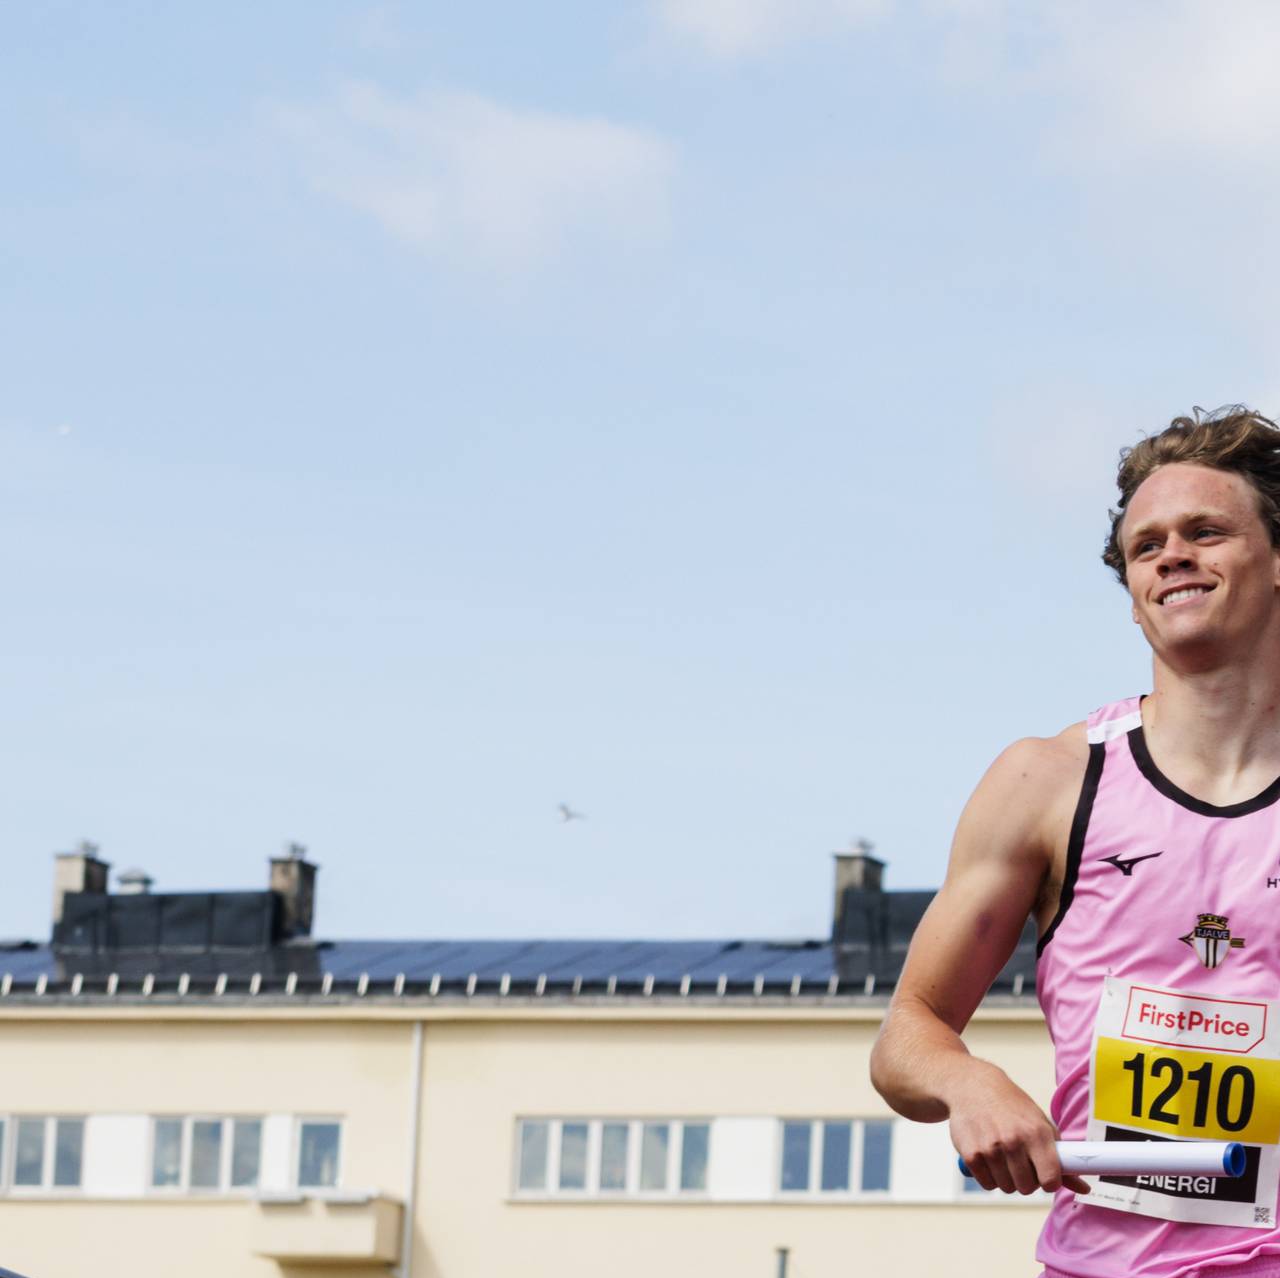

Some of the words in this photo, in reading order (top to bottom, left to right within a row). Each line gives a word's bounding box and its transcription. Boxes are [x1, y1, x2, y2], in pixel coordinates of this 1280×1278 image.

[1196, 927, 1229, 940] TJALVE
[1122, 1052, 1255, 1132] 1210
[1135, 1174, 1217, 1195] ENERGI
